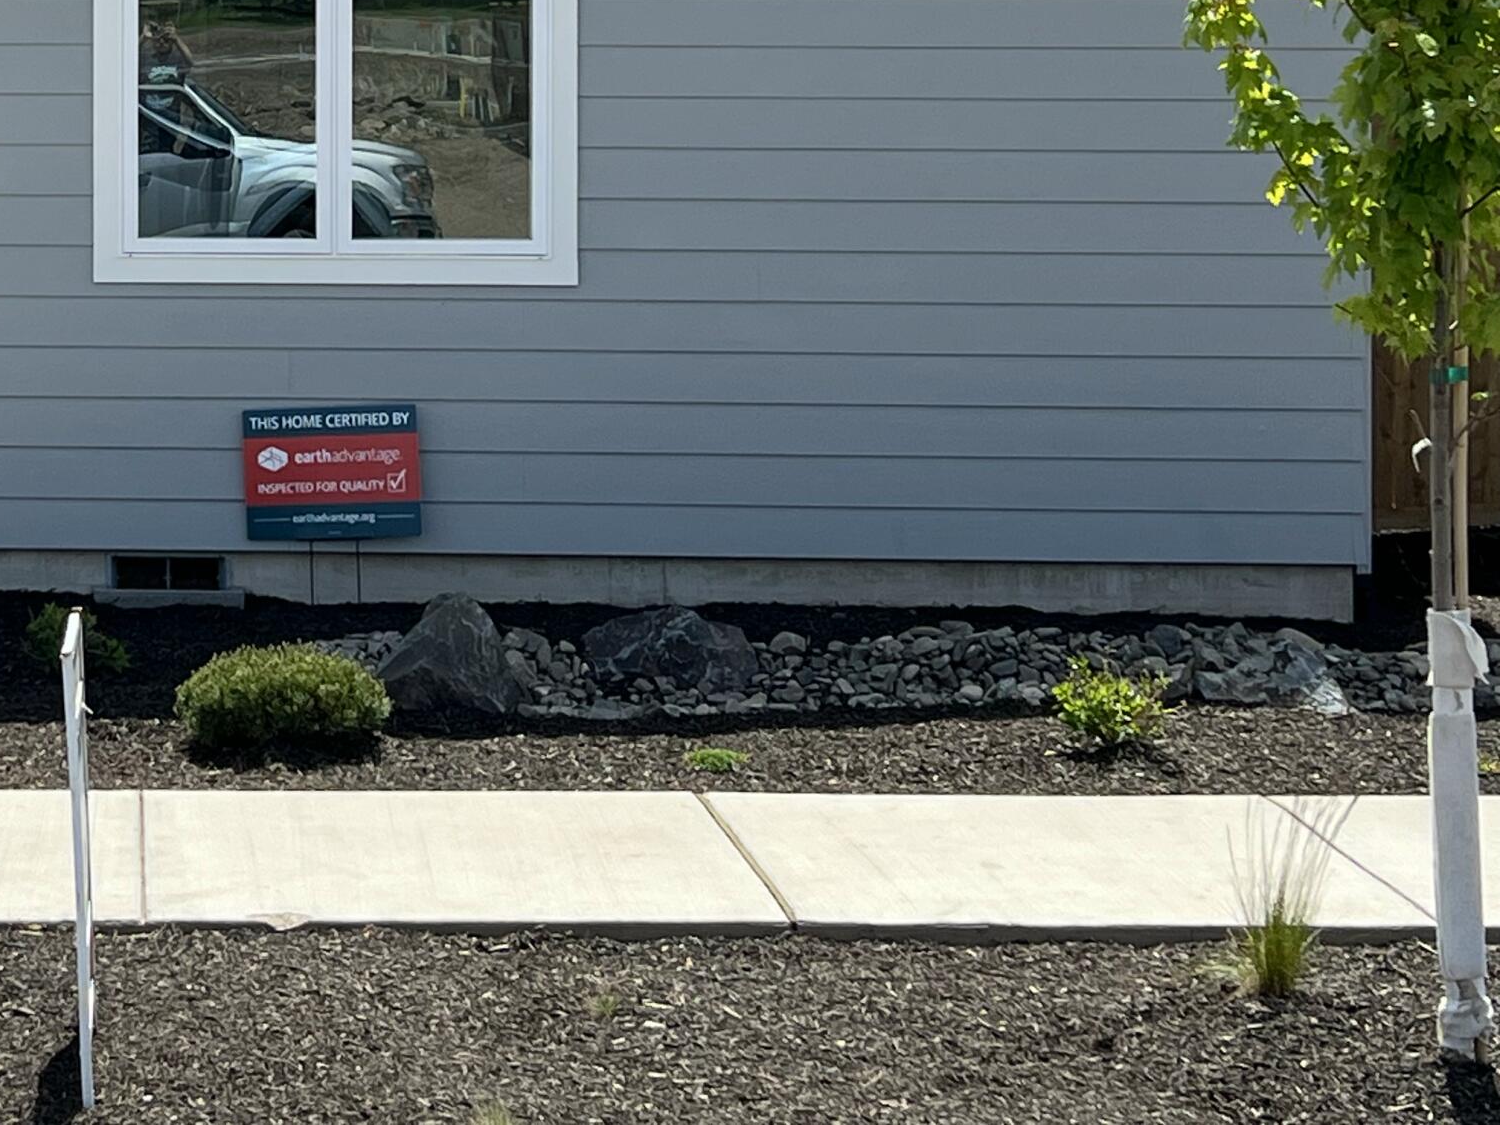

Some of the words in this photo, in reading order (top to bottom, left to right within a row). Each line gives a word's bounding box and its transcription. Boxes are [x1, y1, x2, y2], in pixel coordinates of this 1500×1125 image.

[249, 415, 279, 430] THIS
[281, 414, 323, 429] HOME
[325, 412, 389, 428] CERTIFIED
[392, 411, 410, 425] BY
[294, 448, 401, 465] earthadvantage
[257, 481, 314, 494] INSPECTED
[315, 480, 338, 492] FOR
[339, 479, 385, 493] QUALITY
[292, 513, 376, 524] earthadvantage.org
